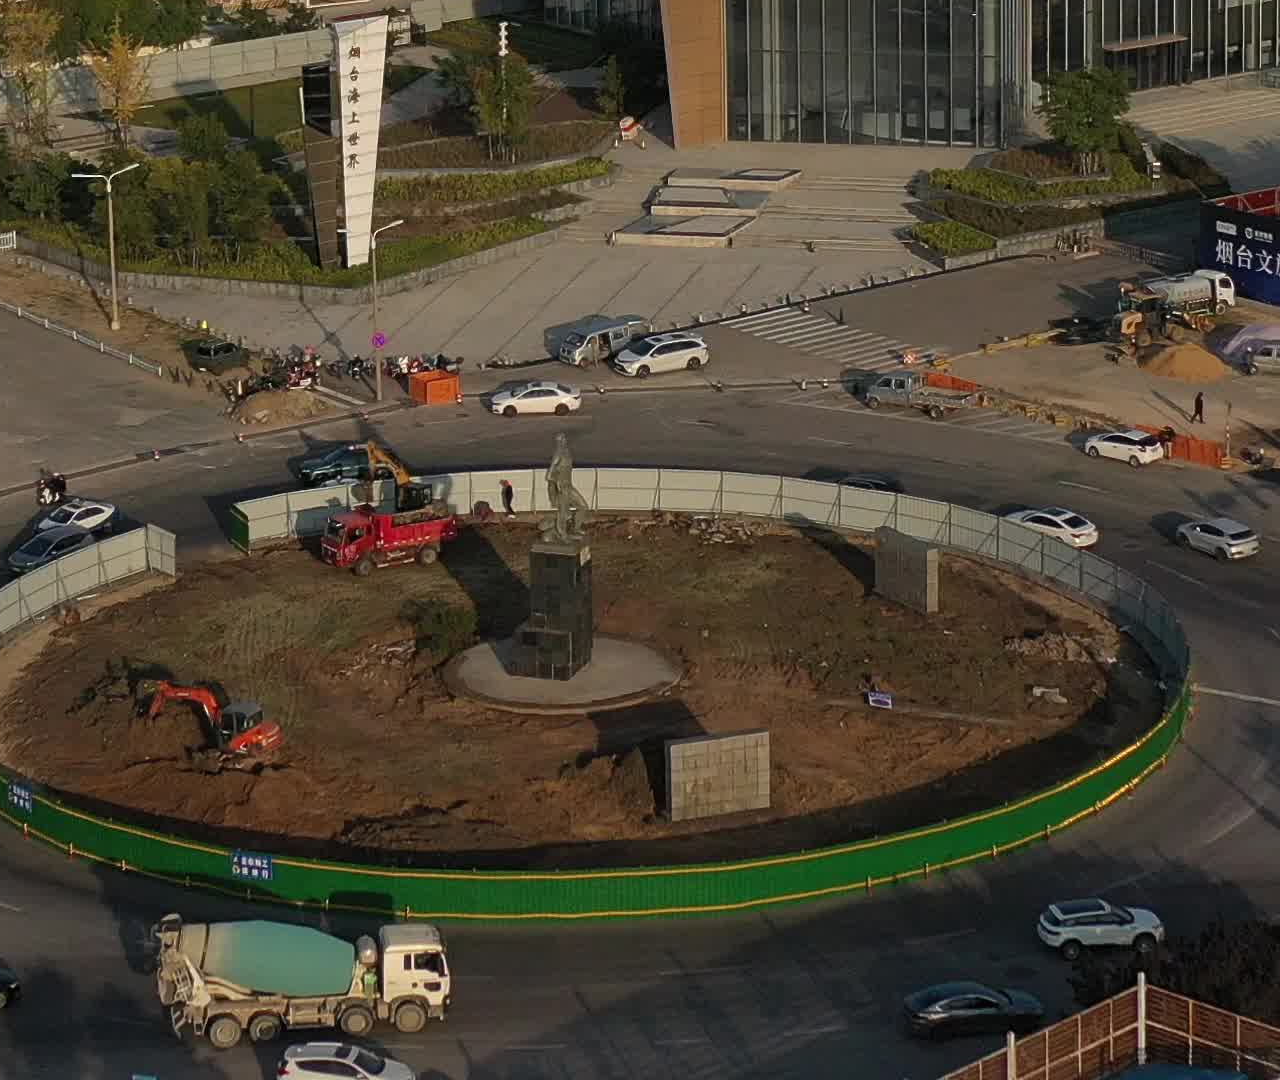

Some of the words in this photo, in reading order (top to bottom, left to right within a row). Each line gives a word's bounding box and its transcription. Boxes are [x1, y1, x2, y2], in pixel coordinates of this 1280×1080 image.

[347, 46, 361, 168] 烟台海上世界
